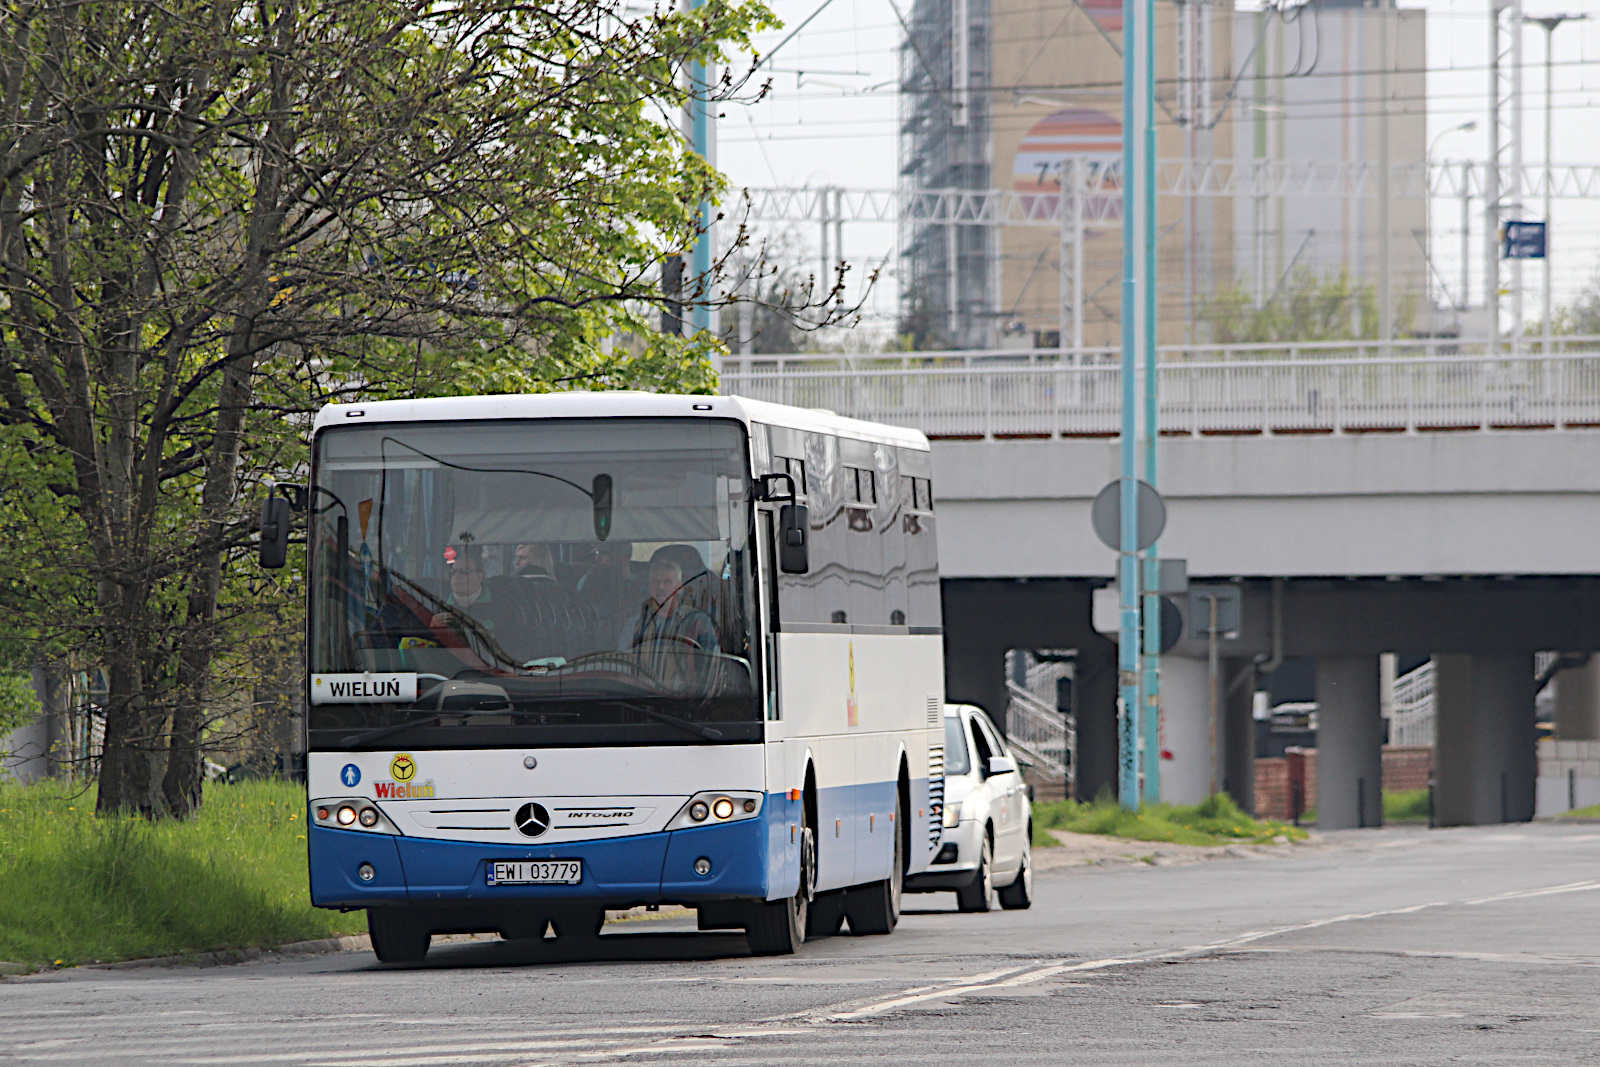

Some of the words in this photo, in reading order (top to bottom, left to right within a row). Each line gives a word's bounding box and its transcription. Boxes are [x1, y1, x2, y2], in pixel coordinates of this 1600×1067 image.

[330, 678, 400, 697] WIELUŃ
[374, 781, 434, 798] Wieluń
[495, 864, 522, 880] EWI
[530, 863, 579, 879] 03779
